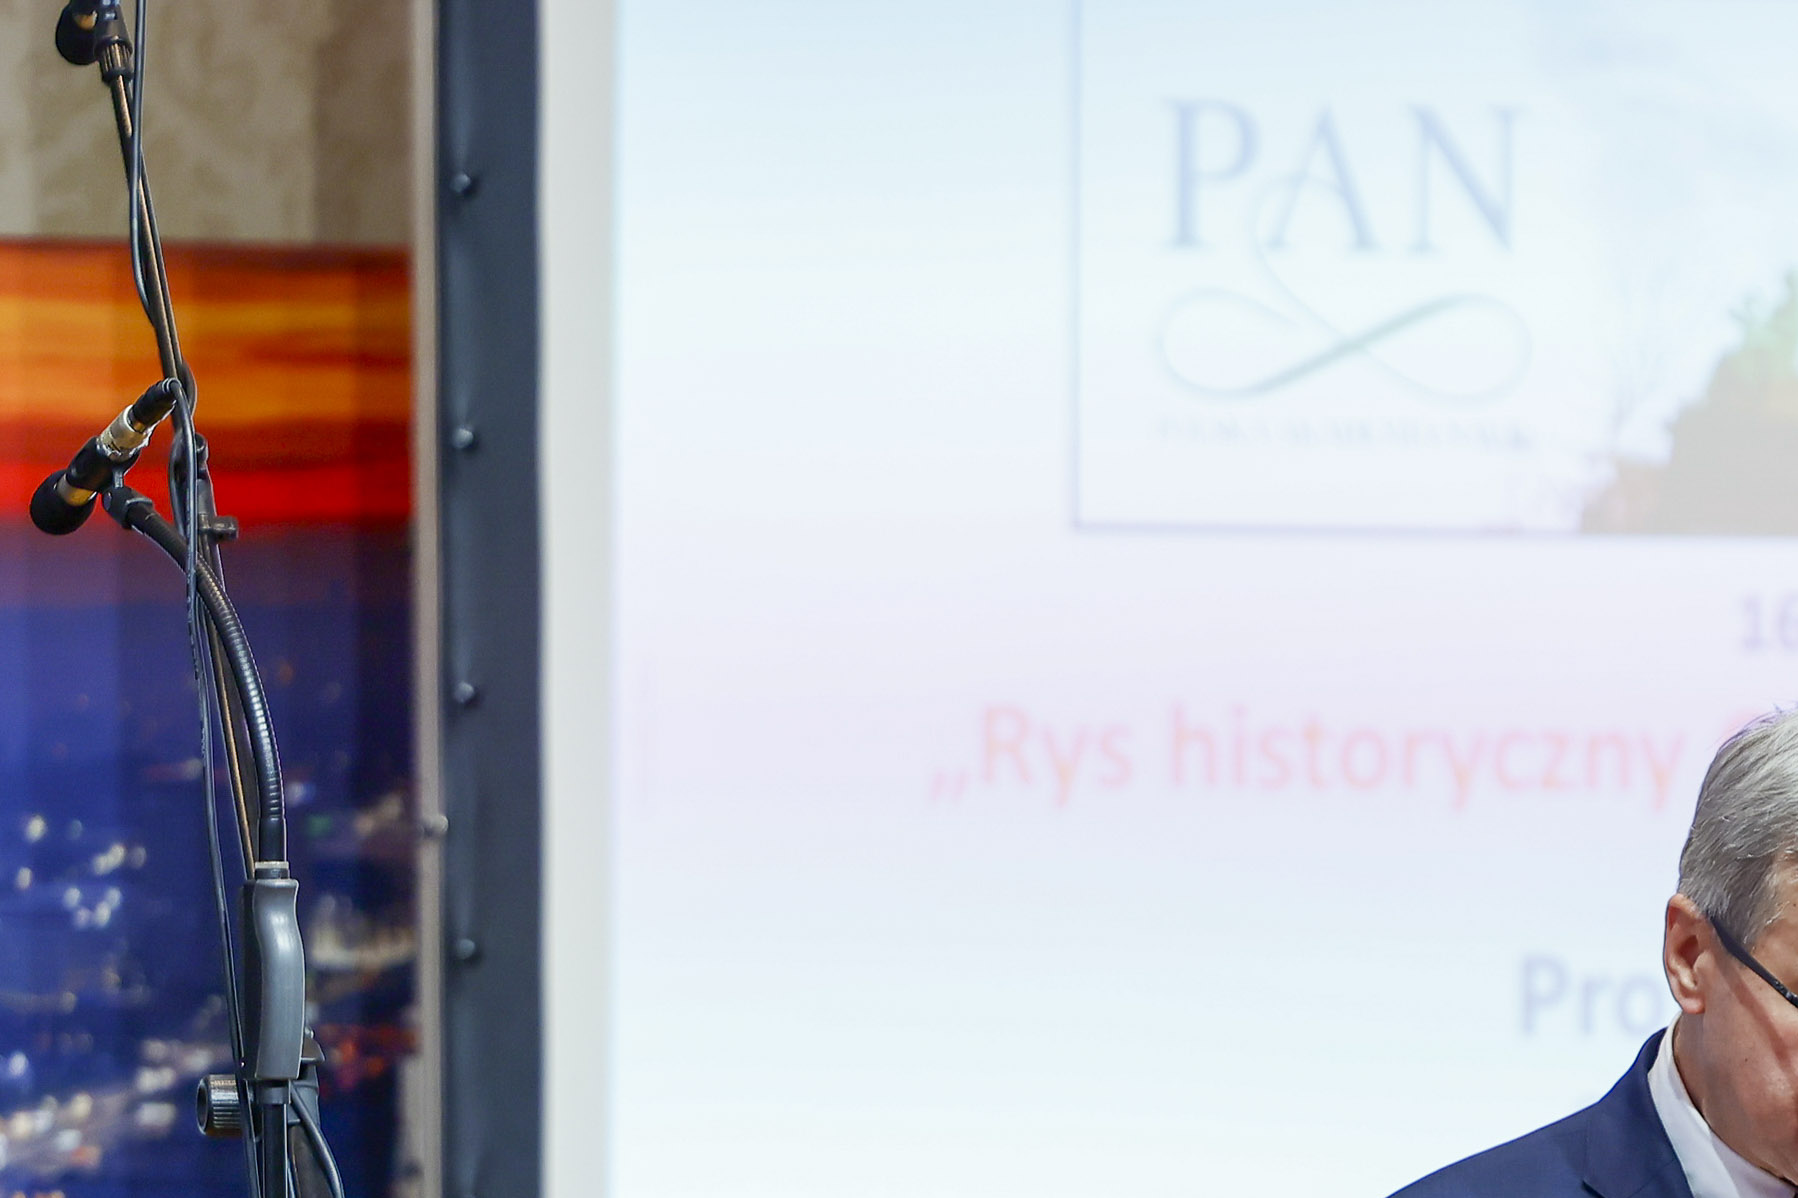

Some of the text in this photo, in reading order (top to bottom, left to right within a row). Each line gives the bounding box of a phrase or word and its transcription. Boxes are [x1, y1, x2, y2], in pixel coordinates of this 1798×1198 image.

[1160, 95, 1532, 256] PAN
[1168, 701, 1687, 815] historyczny
[1516, 952, 1667, 1039] Pro
